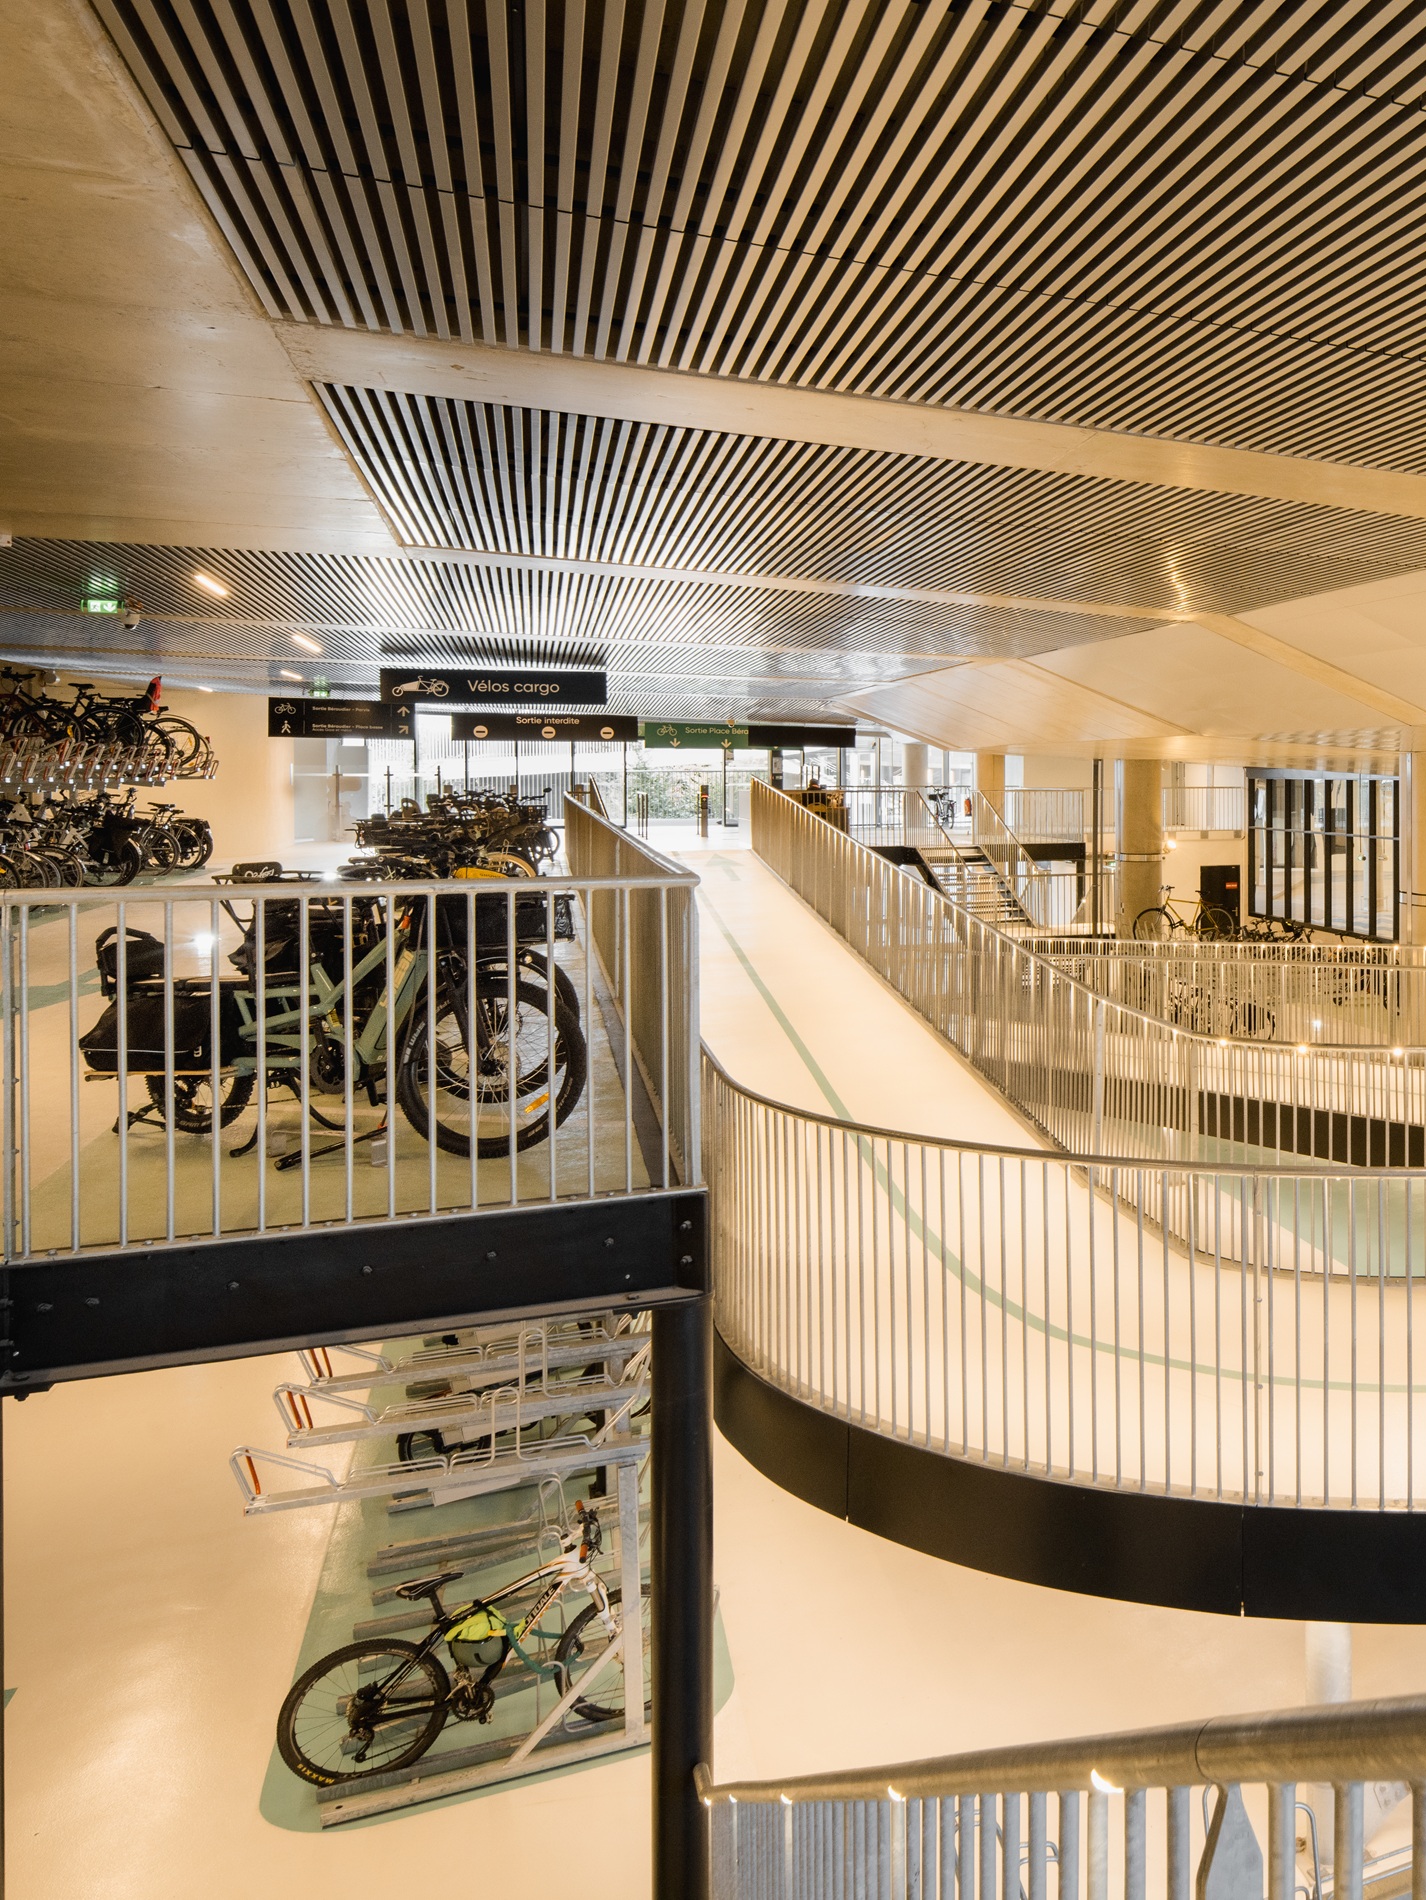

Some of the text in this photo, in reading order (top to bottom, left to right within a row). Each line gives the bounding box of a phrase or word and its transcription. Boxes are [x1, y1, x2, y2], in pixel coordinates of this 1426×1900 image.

[467, 679, 560, 696] Vélos cargo
[516, 716, 580, 725] Sortie interdite
[685, 726, 708, 734] Sortie
